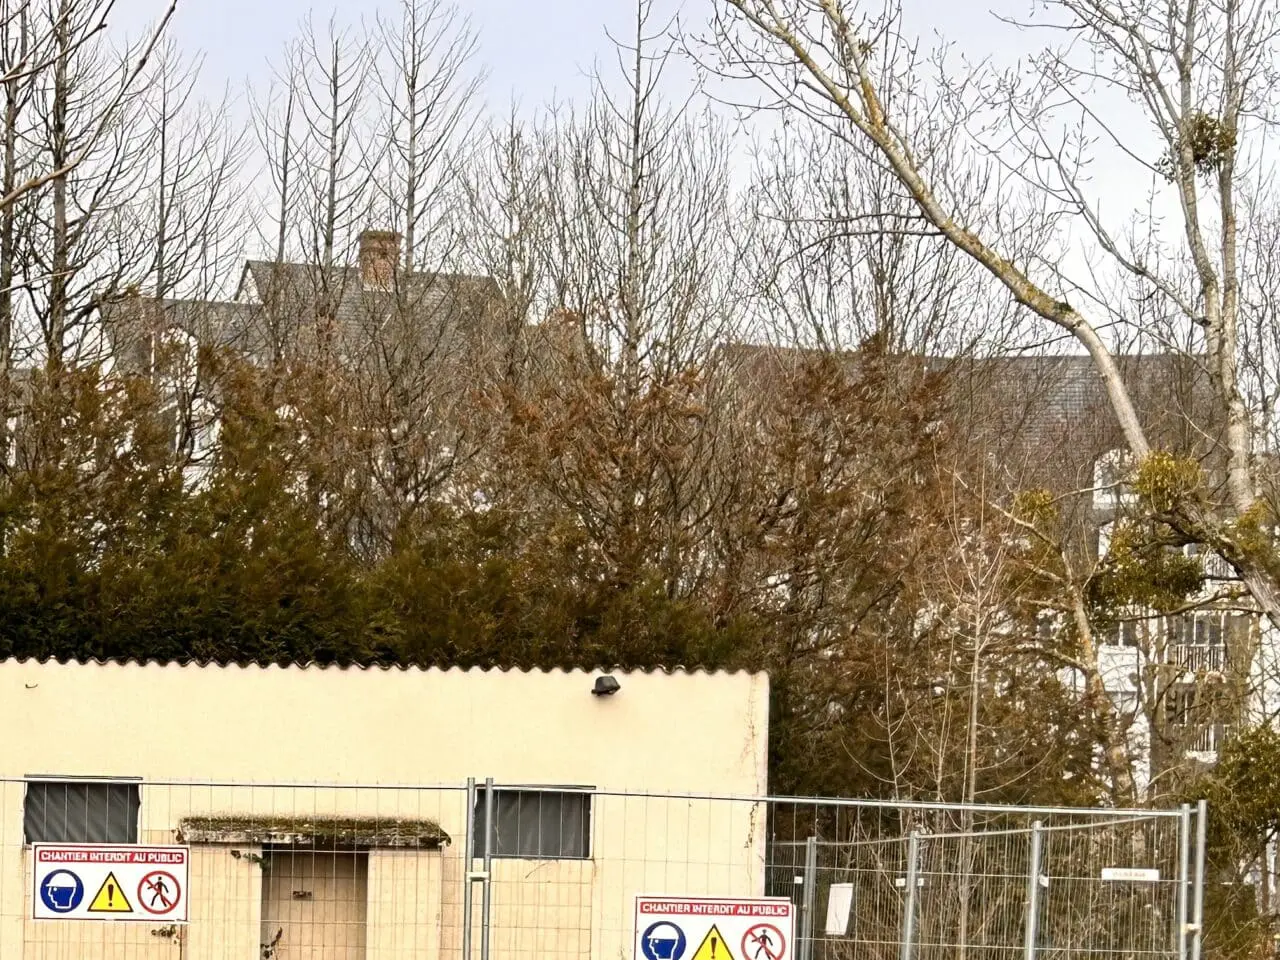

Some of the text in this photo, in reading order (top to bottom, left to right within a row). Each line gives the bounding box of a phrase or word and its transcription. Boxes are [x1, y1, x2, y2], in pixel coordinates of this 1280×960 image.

[41, 851, 183, 863] CHANTIER INTERDIT AU PUBLIC
[642, 903, 787, 916] CHANTIER INTERDIT AU PUBLIC
